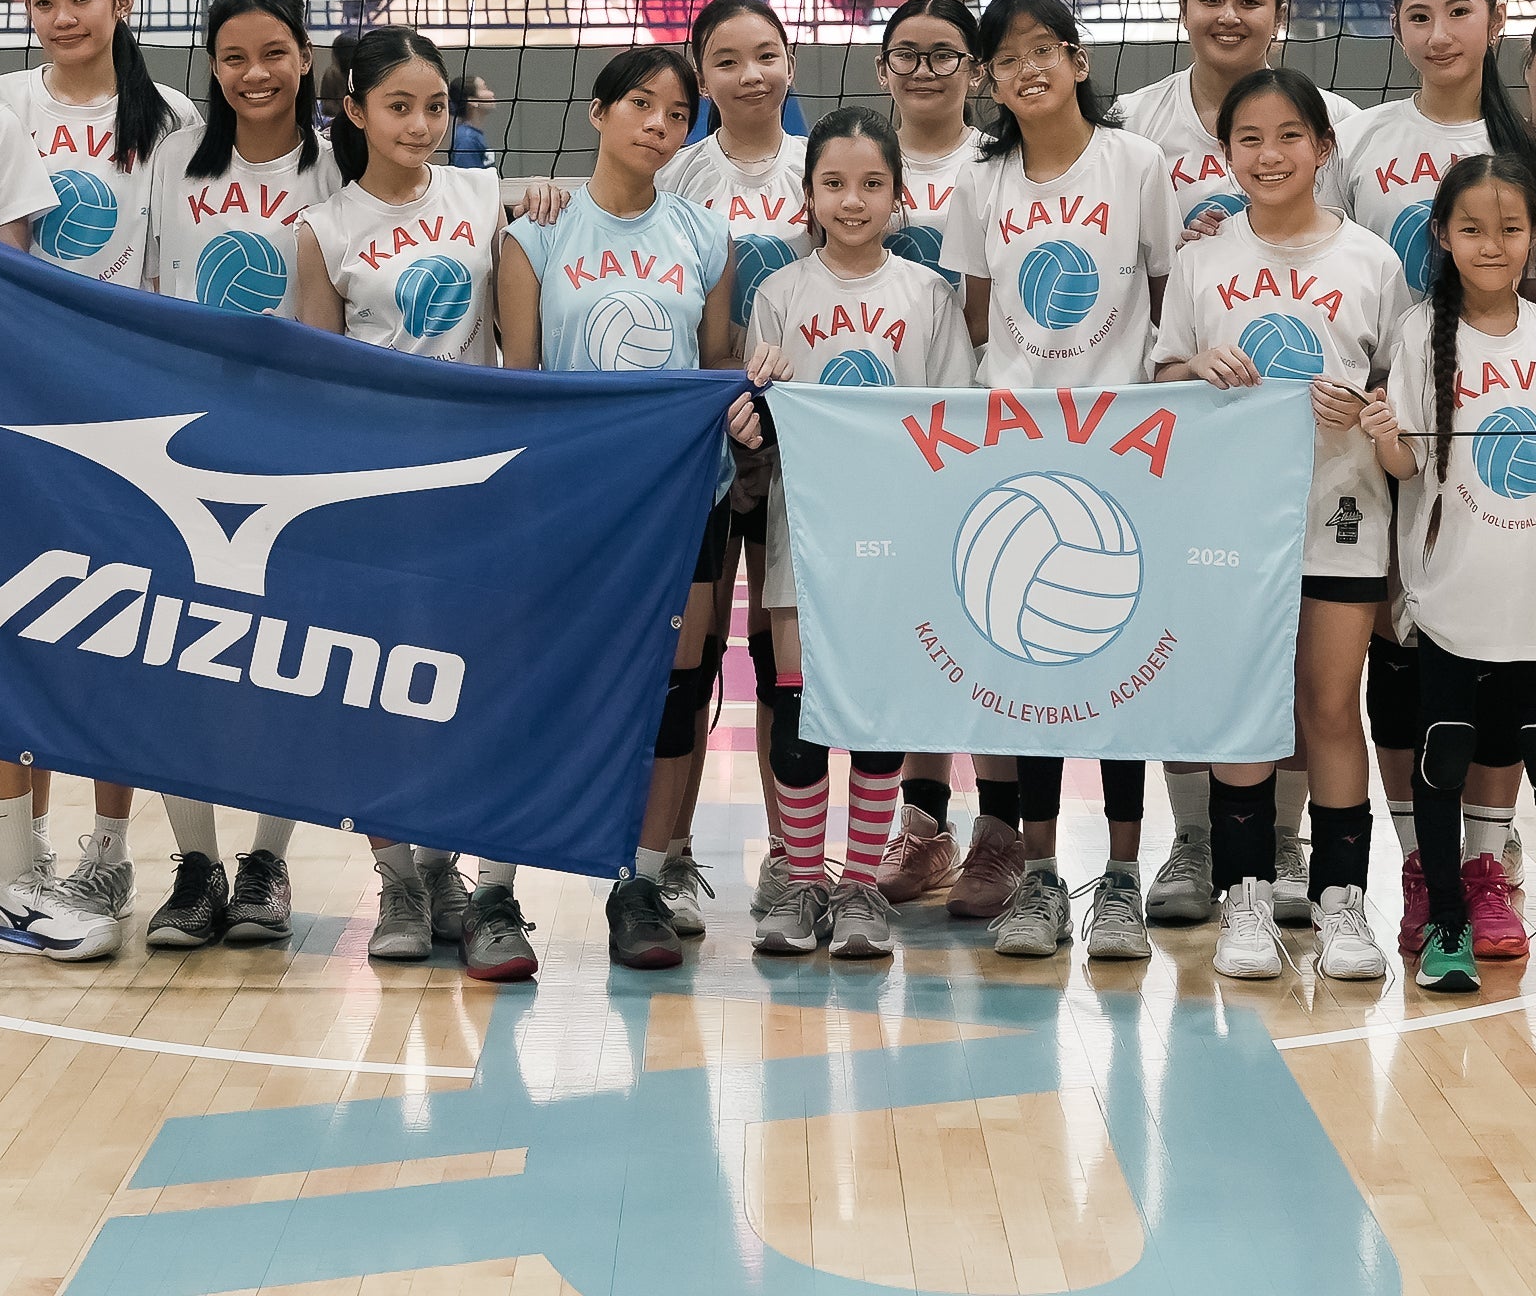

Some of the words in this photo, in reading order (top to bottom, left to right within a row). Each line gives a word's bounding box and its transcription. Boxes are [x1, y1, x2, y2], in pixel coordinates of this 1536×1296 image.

[31, 125, 138, 174] AV
[1170, 154, 1227, 191] KA
[1375, 153, 1459, 194] KA
[704, 193, 813, 237] AVA
[999, 196, 1110, 245] KAVA
[97, 245, 135, 282] ACADEMY
[358, 216, 476, 271] KAVA
[564, 250, 684, 295] KAVA
[1216, 268, 1344, 323] KAVA
[459, 317, 484, 355] ACADEMY
[799, 302, 907, 353] KAVA
[1005, 315, 1024, 344] KAITO
[1026, 343, 1085, 359] VOLLEYBALL
[1089, 307, 1120, 348] ACADEMY
[902, 388, 1177, 478] KAVA
[1456, 483, 1479, 513] KAITO
[855, 540, 897, 558] EST.
[1187, 547, 1240, 567] 2026
[915, 621, 964, 684] KAITO
[970, 682, 1100, 725] VOLLEYBALL
[1110, 628, 1179, 709] ACADEMY
